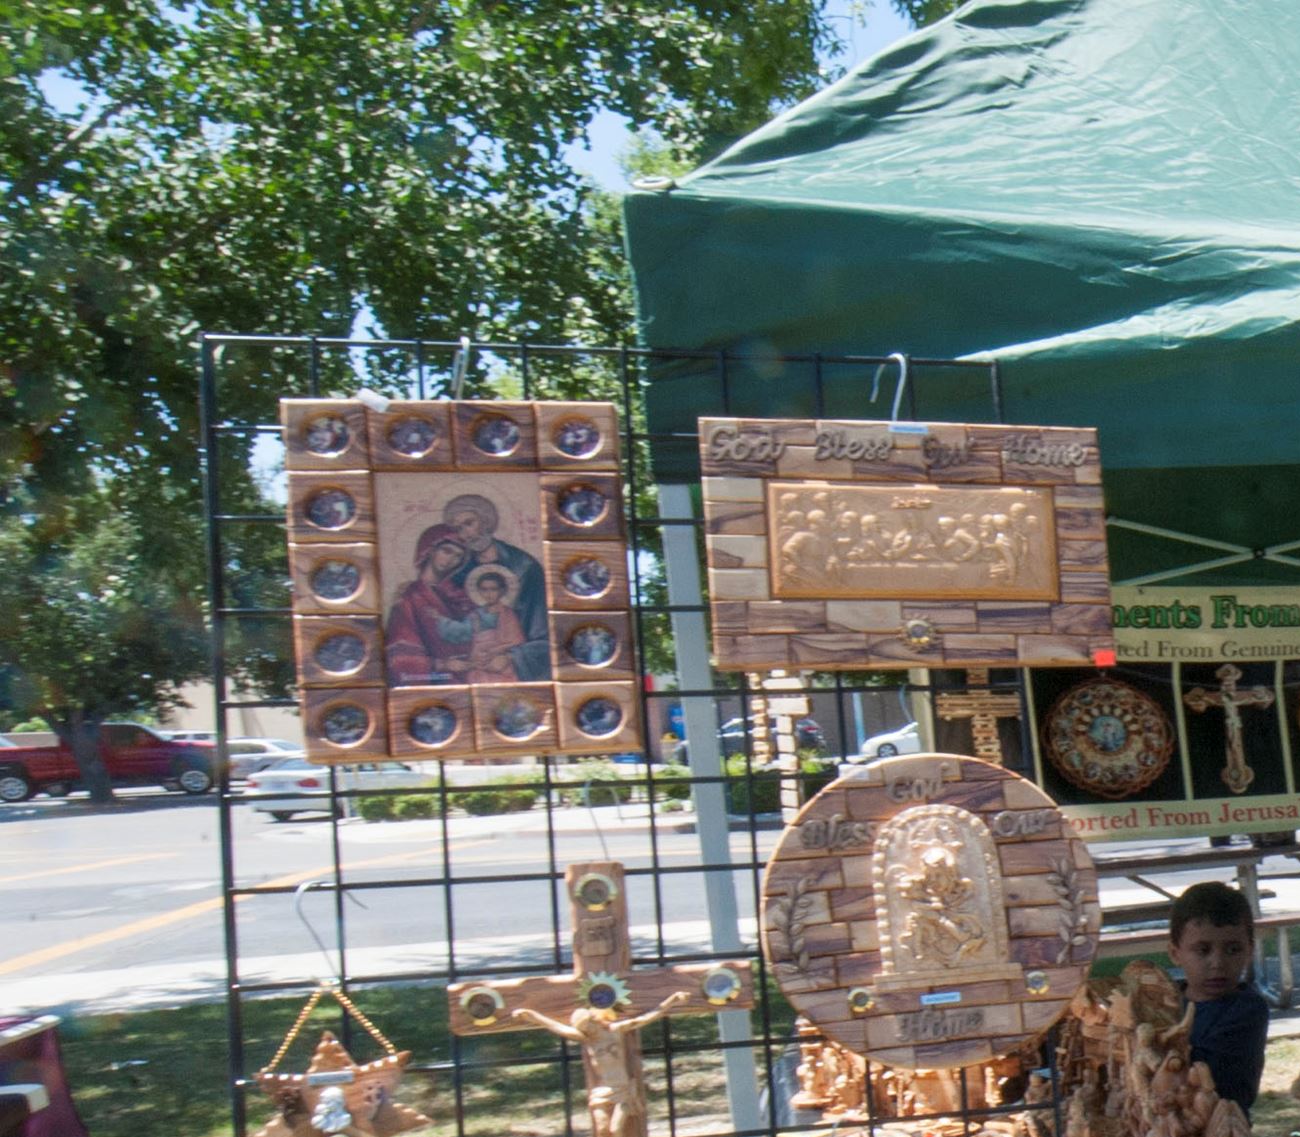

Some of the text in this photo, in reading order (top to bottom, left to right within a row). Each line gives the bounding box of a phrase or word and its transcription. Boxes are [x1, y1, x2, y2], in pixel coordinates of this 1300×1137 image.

[814, 428, 894, 462] Bless
[1001, 434, 1089, 469] Home
[1157, 640, 1214, 658] From
[1146, 807, 1211, 828] From
